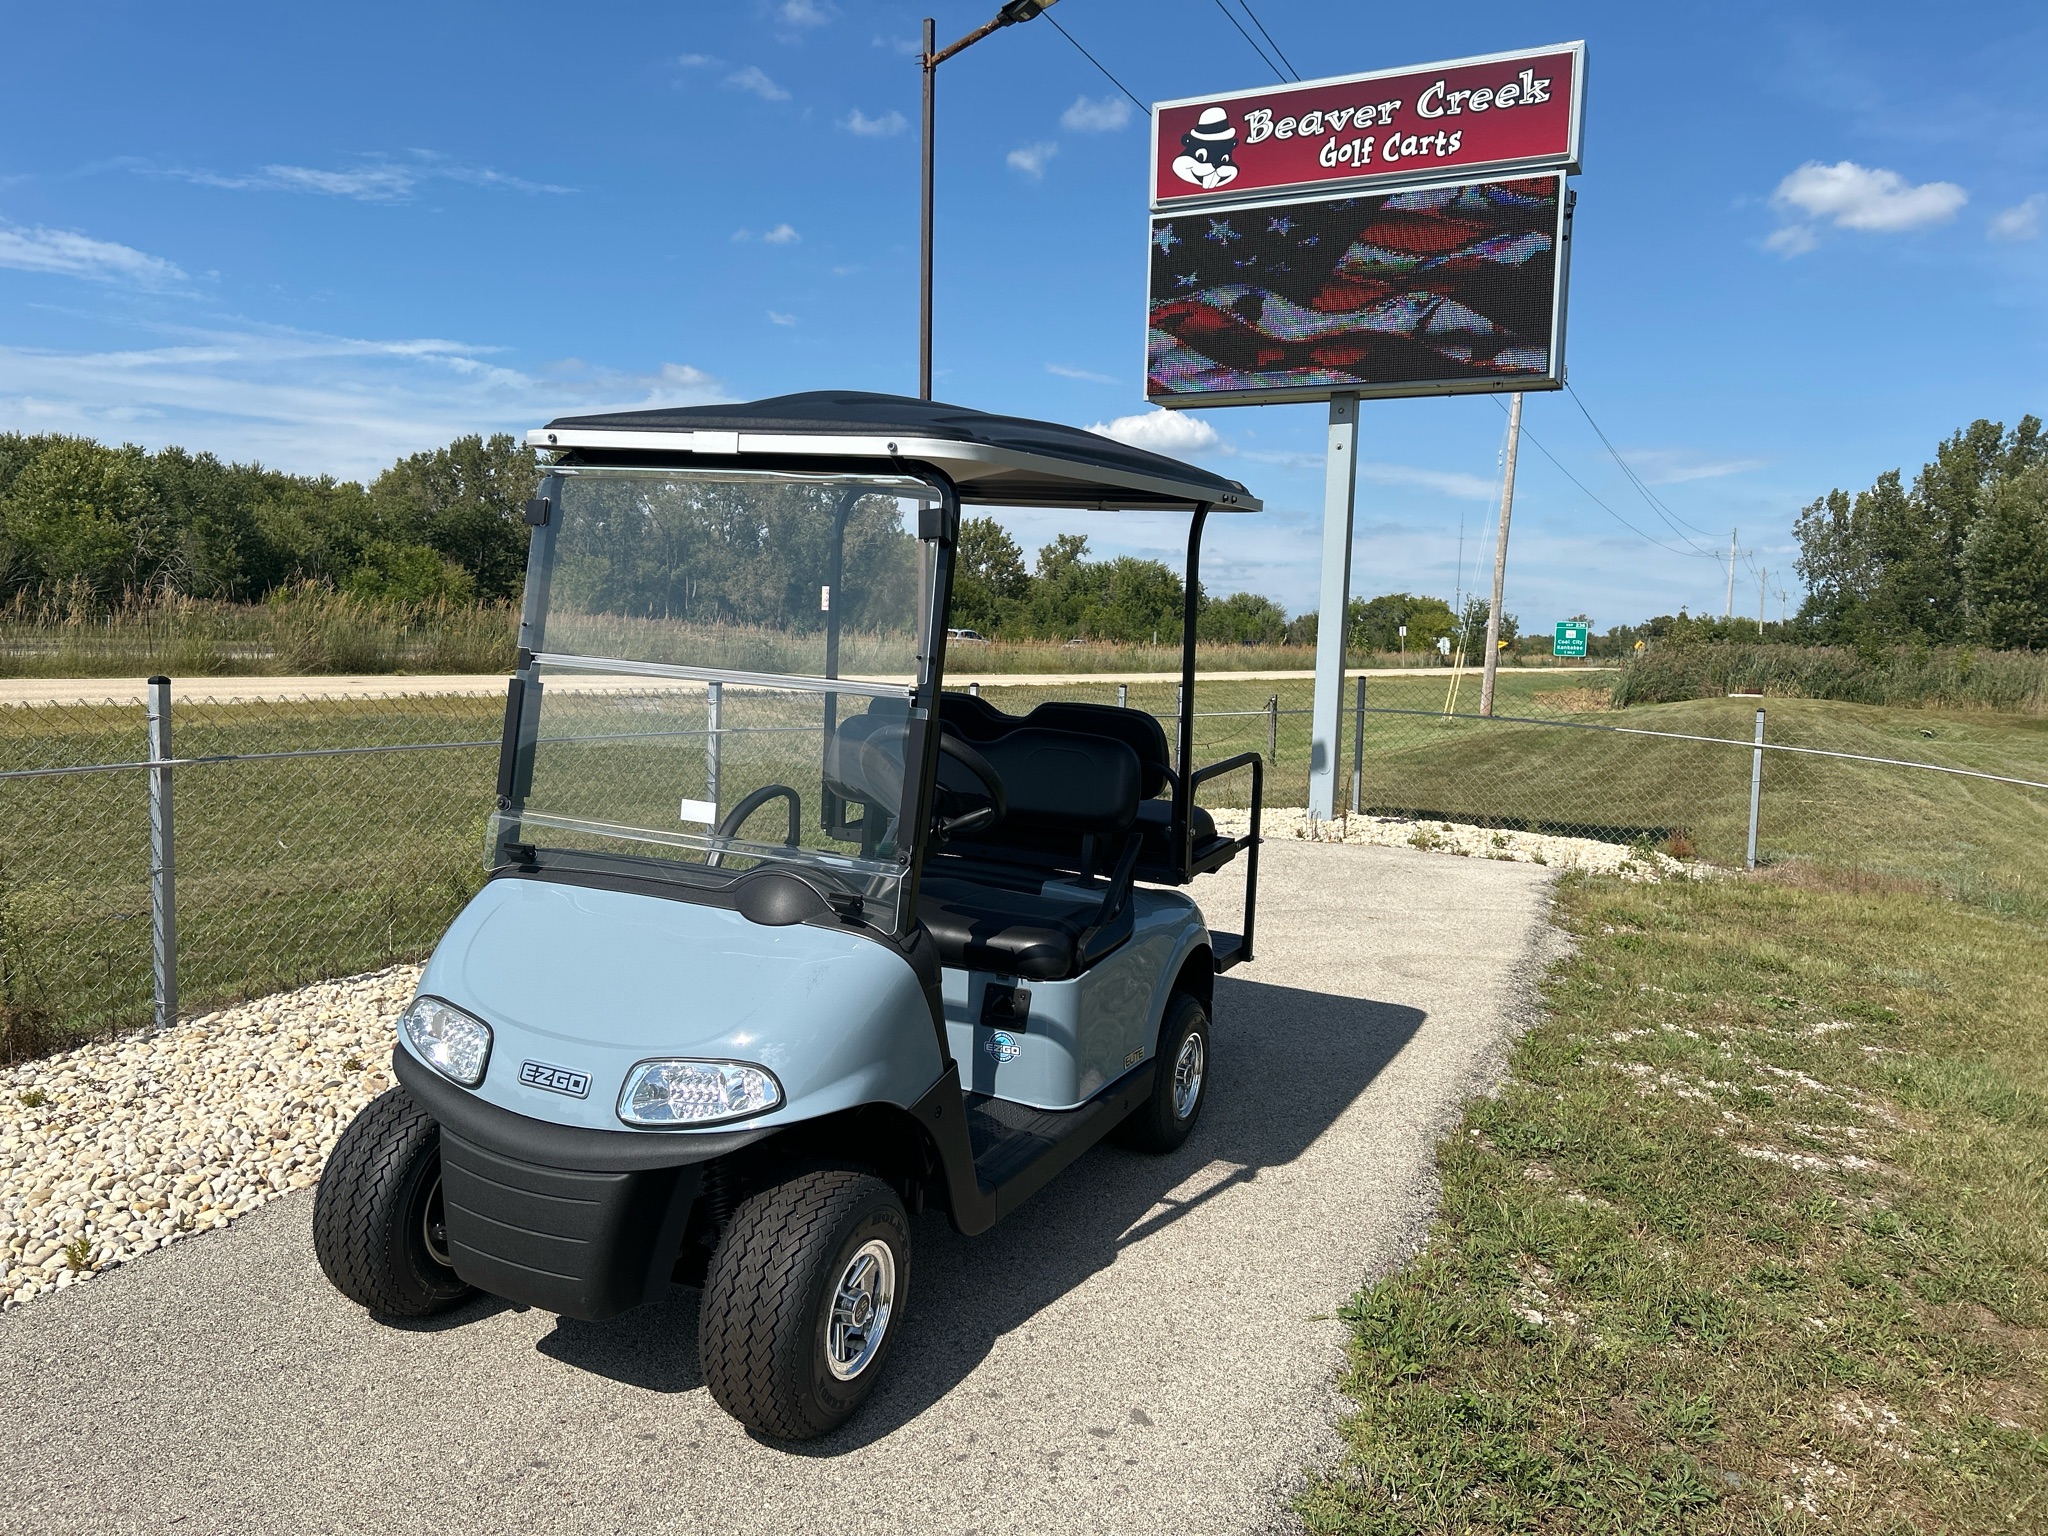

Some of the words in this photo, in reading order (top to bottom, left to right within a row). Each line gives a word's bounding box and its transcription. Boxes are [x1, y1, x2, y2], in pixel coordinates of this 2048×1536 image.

[1243, 99, 1402, 144] Beaver
[1416, 68, 1551, 119] Creek
[1319, 136, 1375, 168] Golf
[1382, 130, 1463, 162] Carts
[1125, 1046, 1144, 1068] ELITE
[520, 1063, 587, 1093] EZGO
